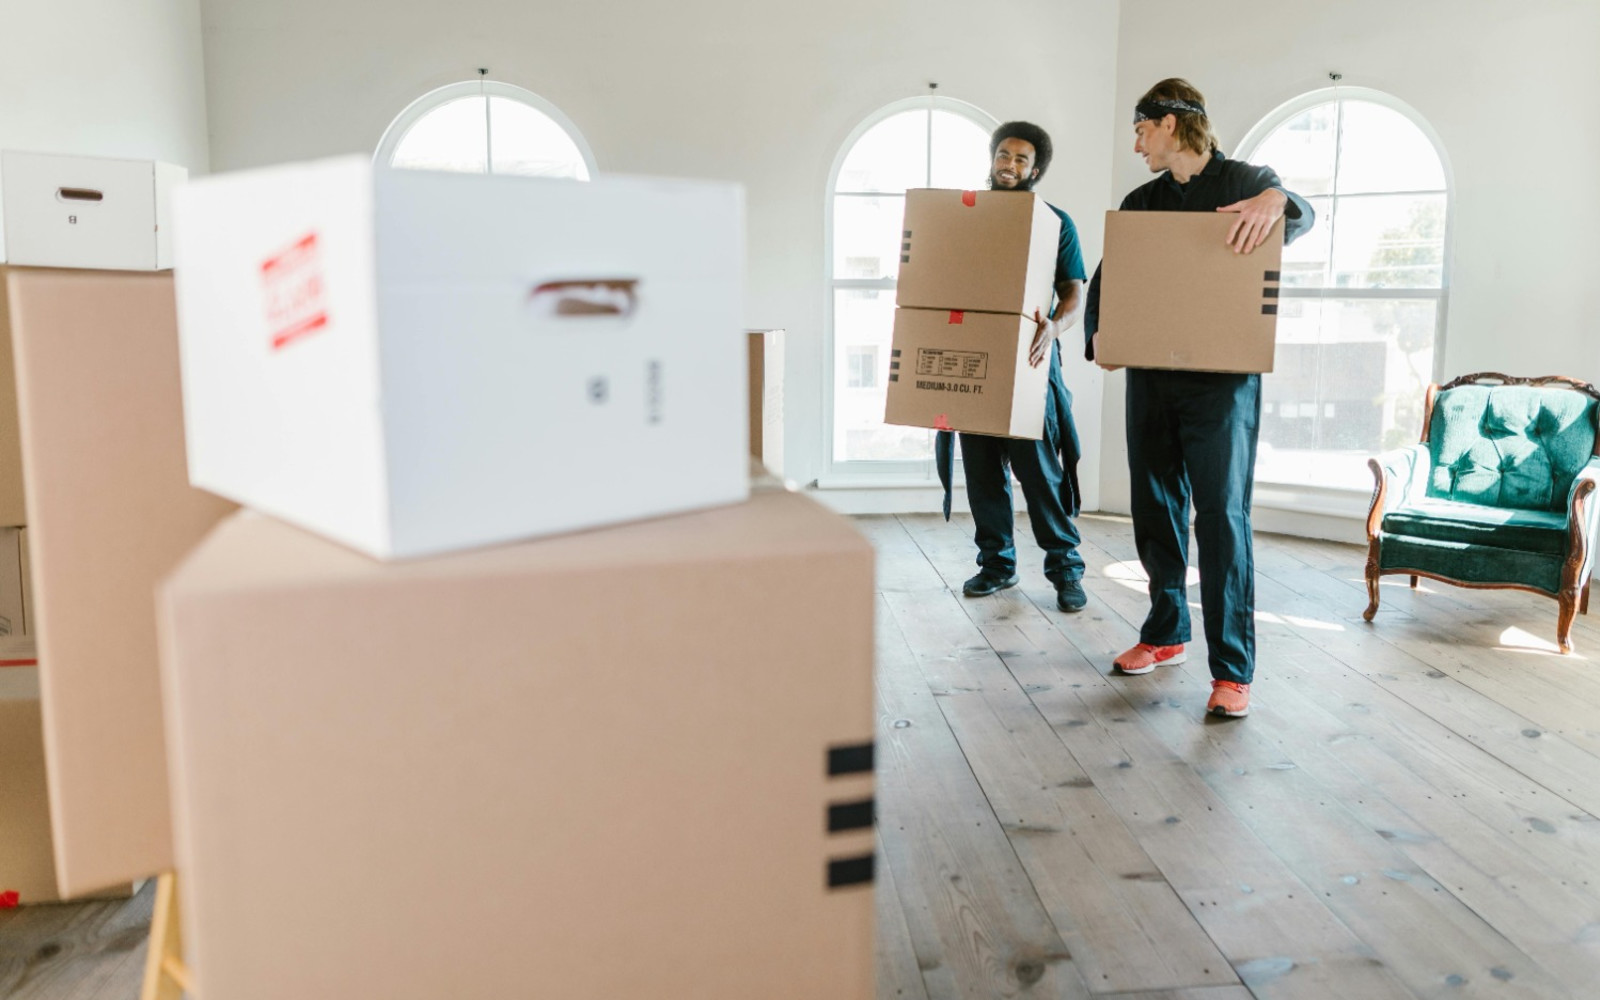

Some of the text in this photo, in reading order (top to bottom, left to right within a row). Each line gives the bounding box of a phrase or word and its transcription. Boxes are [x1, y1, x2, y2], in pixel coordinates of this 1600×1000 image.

[916, 380, 983, 395] MEDIUM-3.0 CU. FT.
